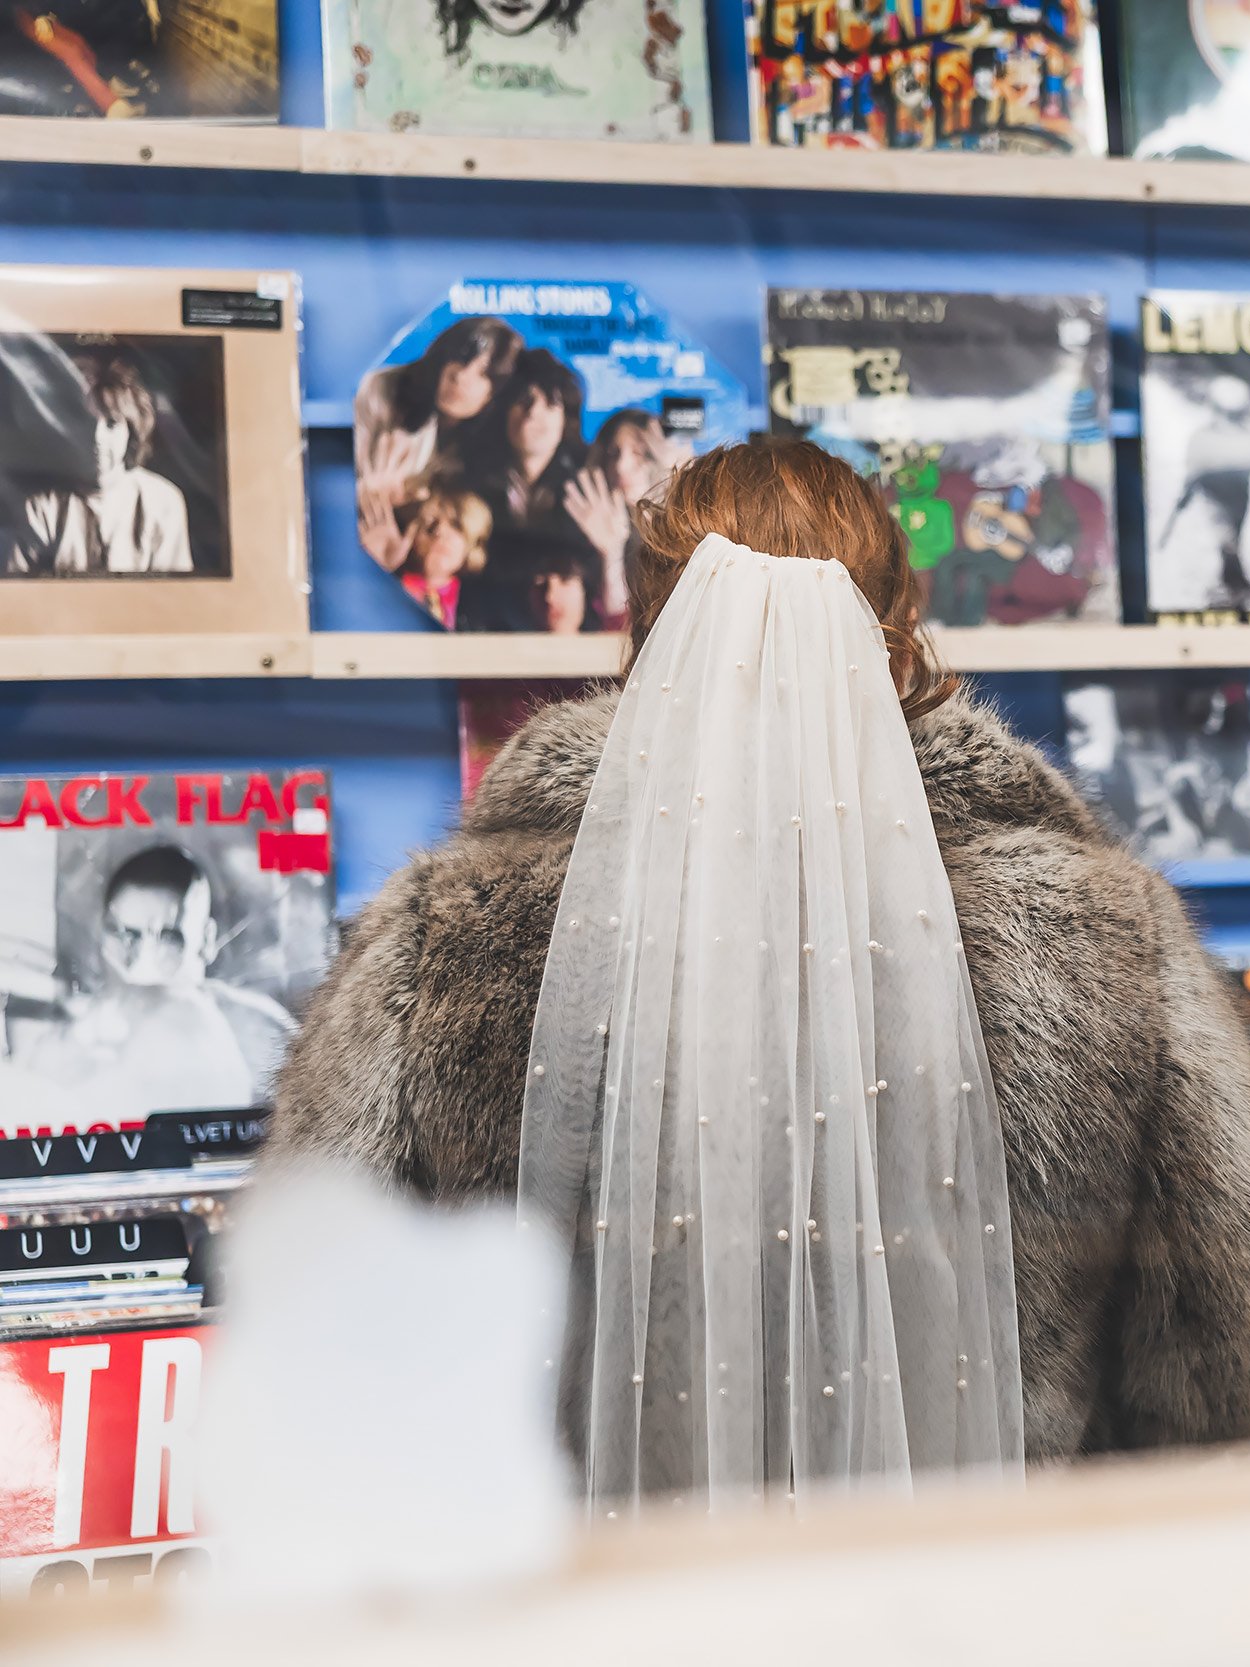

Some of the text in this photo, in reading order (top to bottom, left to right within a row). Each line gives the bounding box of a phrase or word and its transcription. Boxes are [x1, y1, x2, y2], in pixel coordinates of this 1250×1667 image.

[449, 284, 612, 316] ROLLING STONES
[0, 771, 328, 828] ACK FLAG
[31, 1133, 142, 1167] V V V
[21, 1223, 141, 1259] U U U
